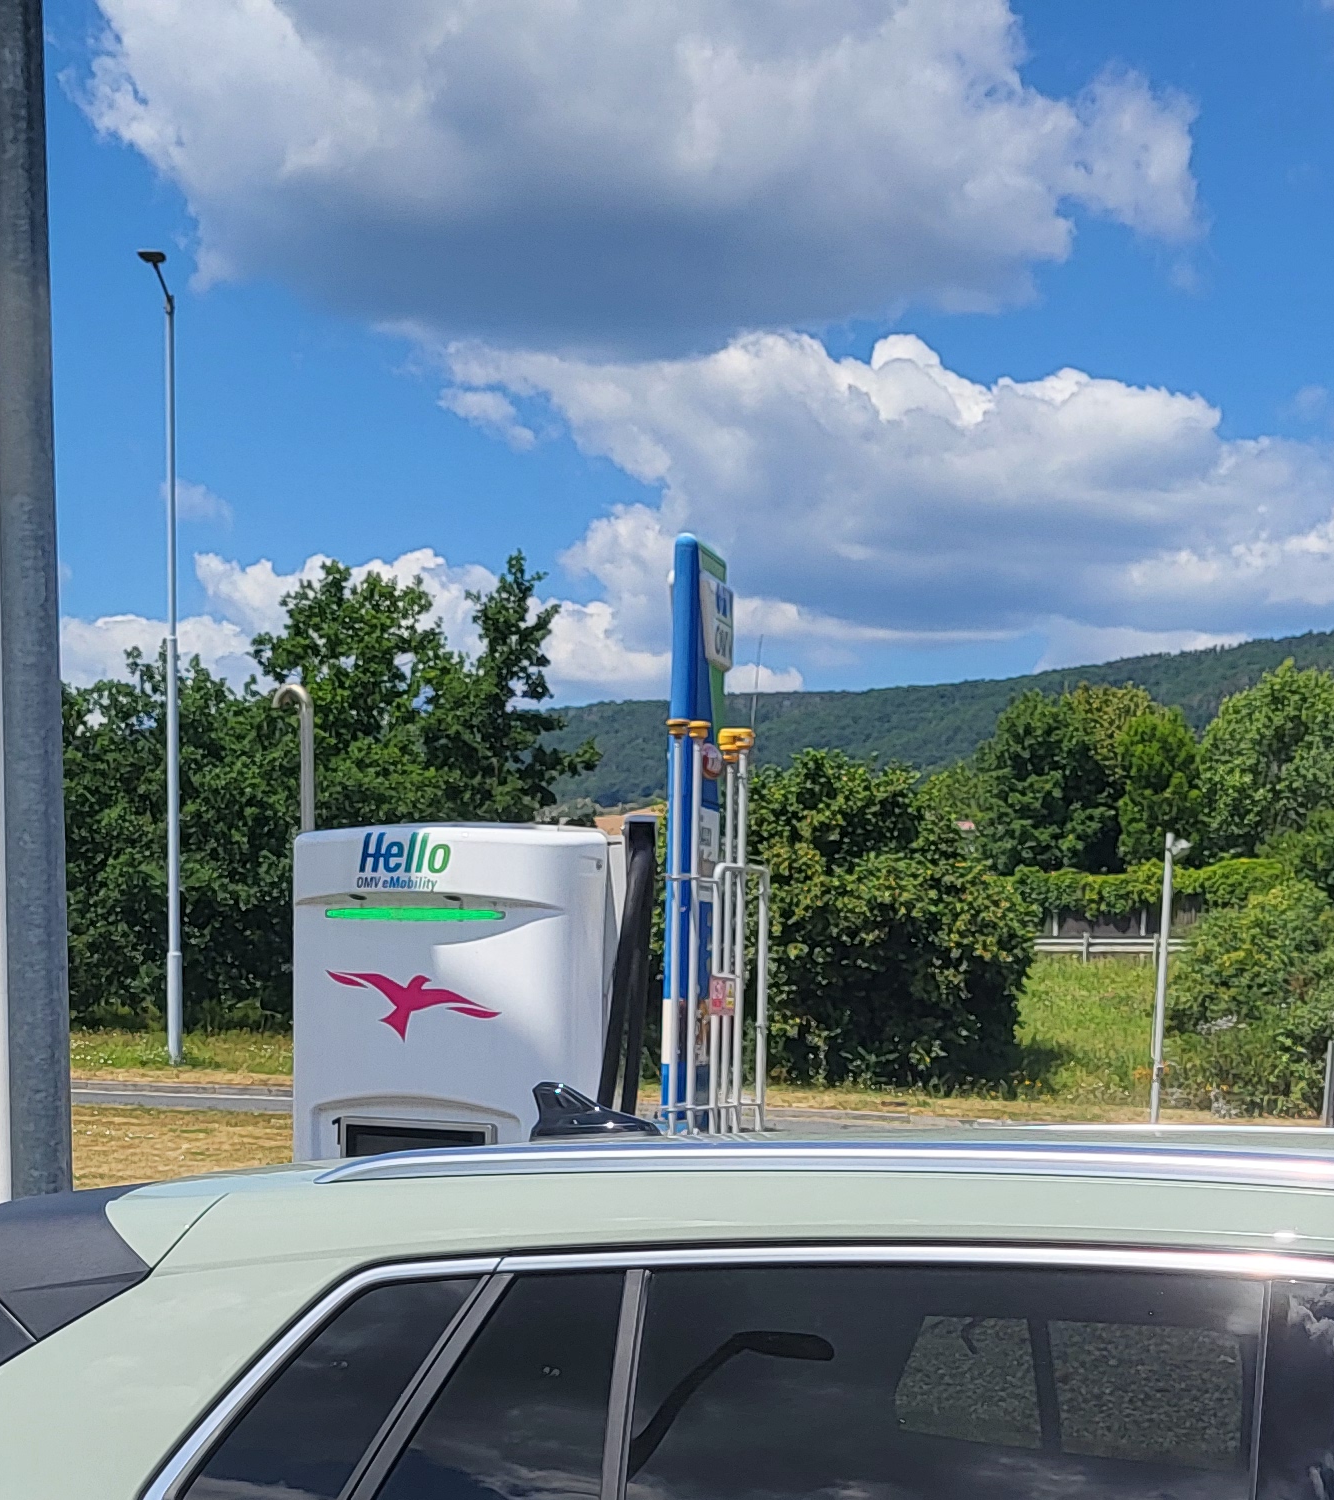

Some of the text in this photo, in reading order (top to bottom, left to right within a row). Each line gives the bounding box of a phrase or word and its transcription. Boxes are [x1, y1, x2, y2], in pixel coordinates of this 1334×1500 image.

[358, 831, 452, 874] Hello
[356, 876, 438, 894] OMV eMobility
